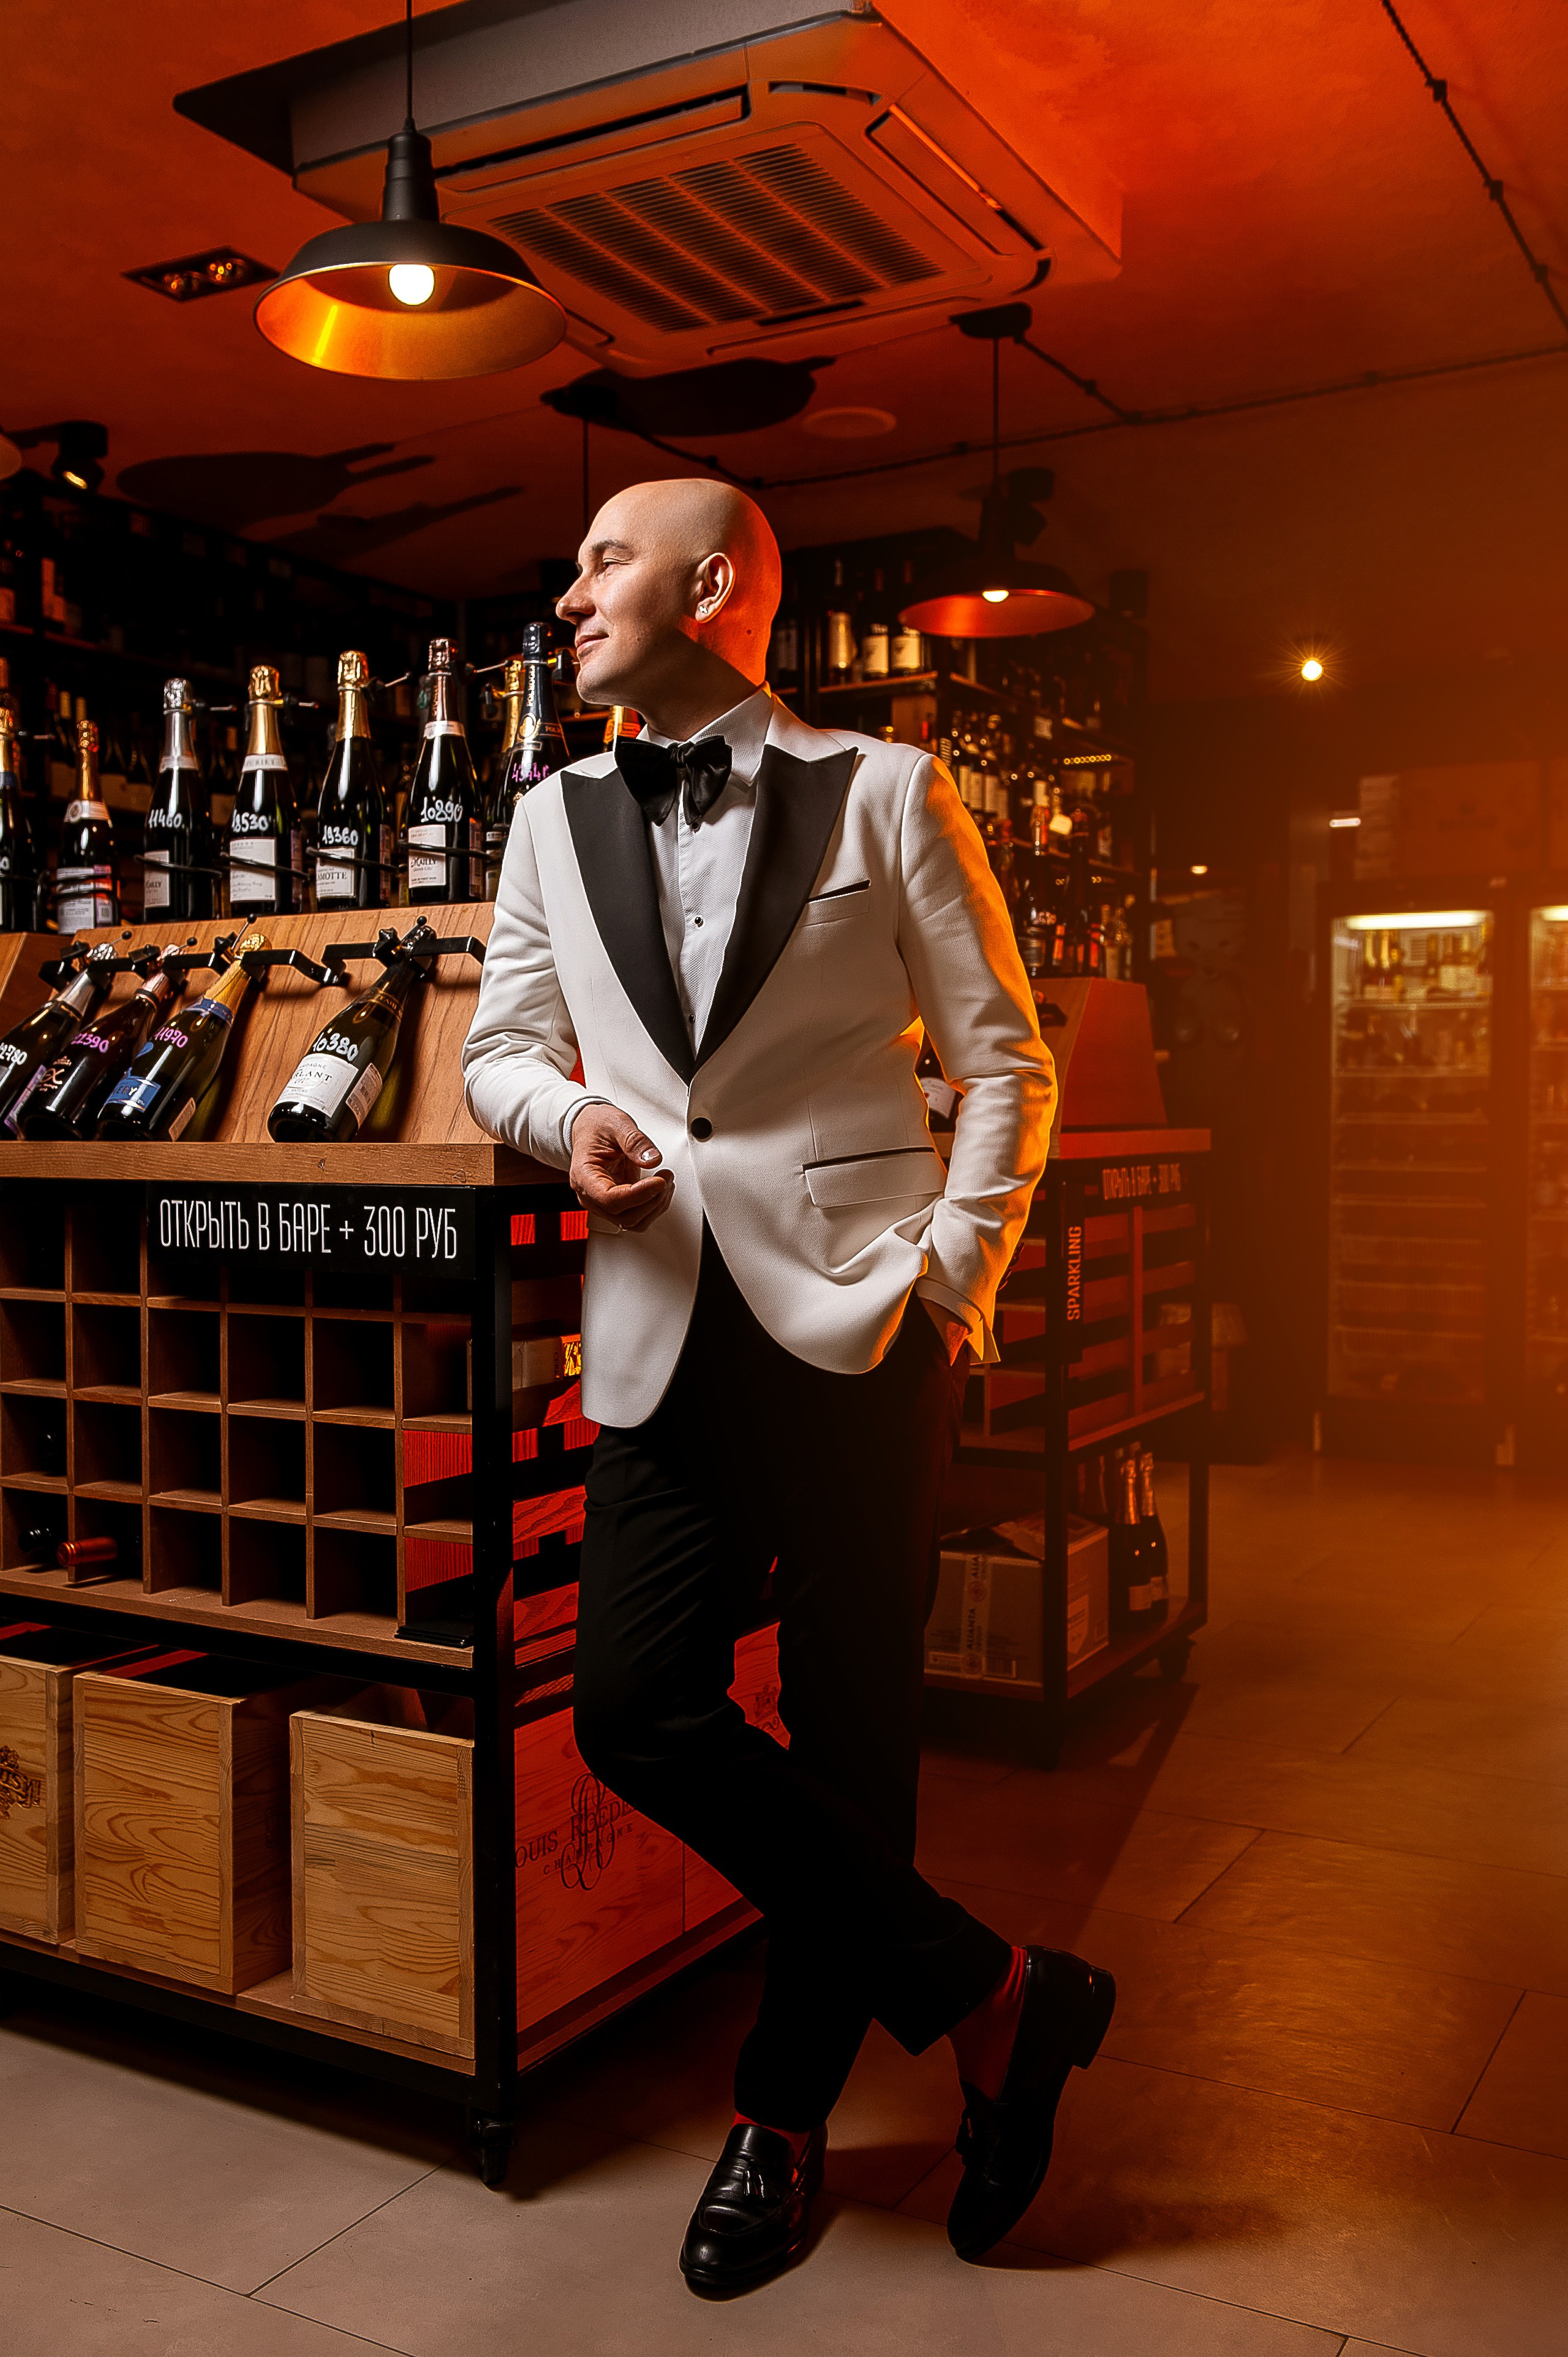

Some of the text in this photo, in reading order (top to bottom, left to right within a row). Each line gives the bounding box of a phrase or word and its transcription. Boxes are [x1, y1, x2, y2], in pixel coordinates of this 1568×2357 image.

[160, 1199, 457, 1259] ОТКРЫТЬ В БАРЕ + 300 РУБ
[1067, 1226, 1082, 1320] SPARKLING
[516, 1829, 559, 1868] OUIS
